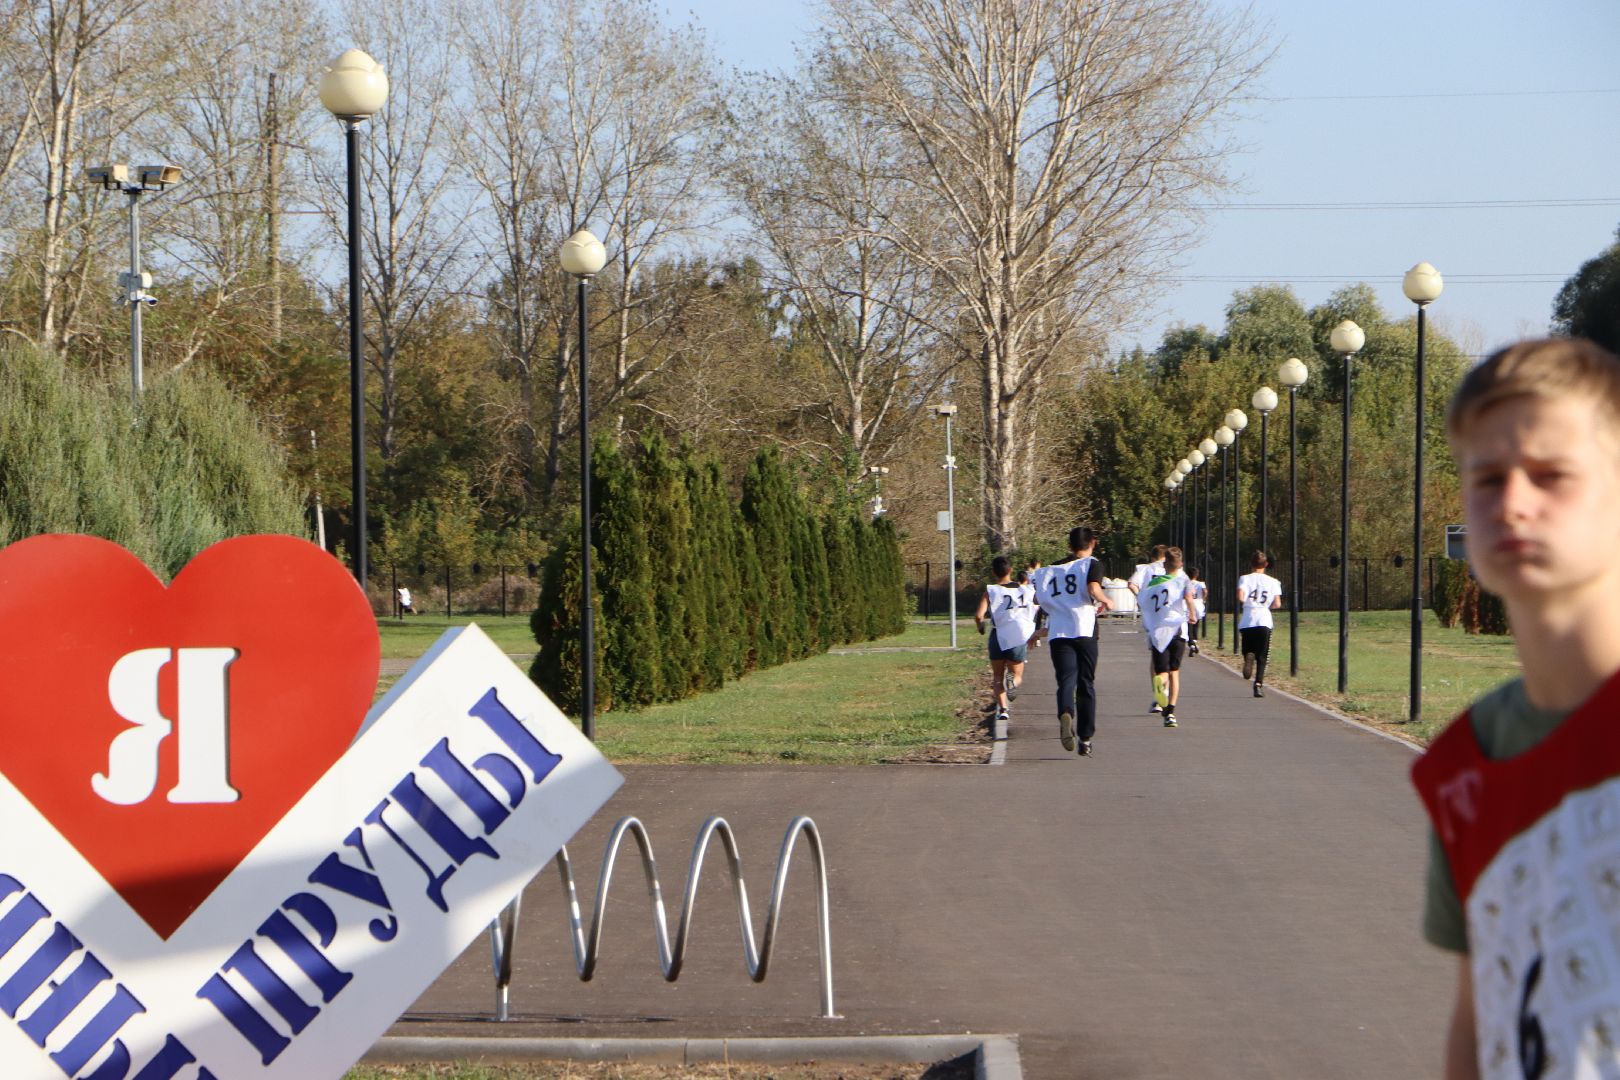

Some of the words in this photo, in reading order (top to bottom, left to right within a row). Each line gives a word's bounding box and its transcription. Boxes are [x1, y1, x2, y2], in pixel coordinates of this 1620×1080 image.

[1048, 574, 1077, 598] 18
[1248, 588, 1269, 604] 45
[1003, 594, 1028, 611] 21
[1151, 588, 1170, 613] 22
[91, 647, 242, 805] Я
[196, 686, 563, 1067] ПРУДЫ
